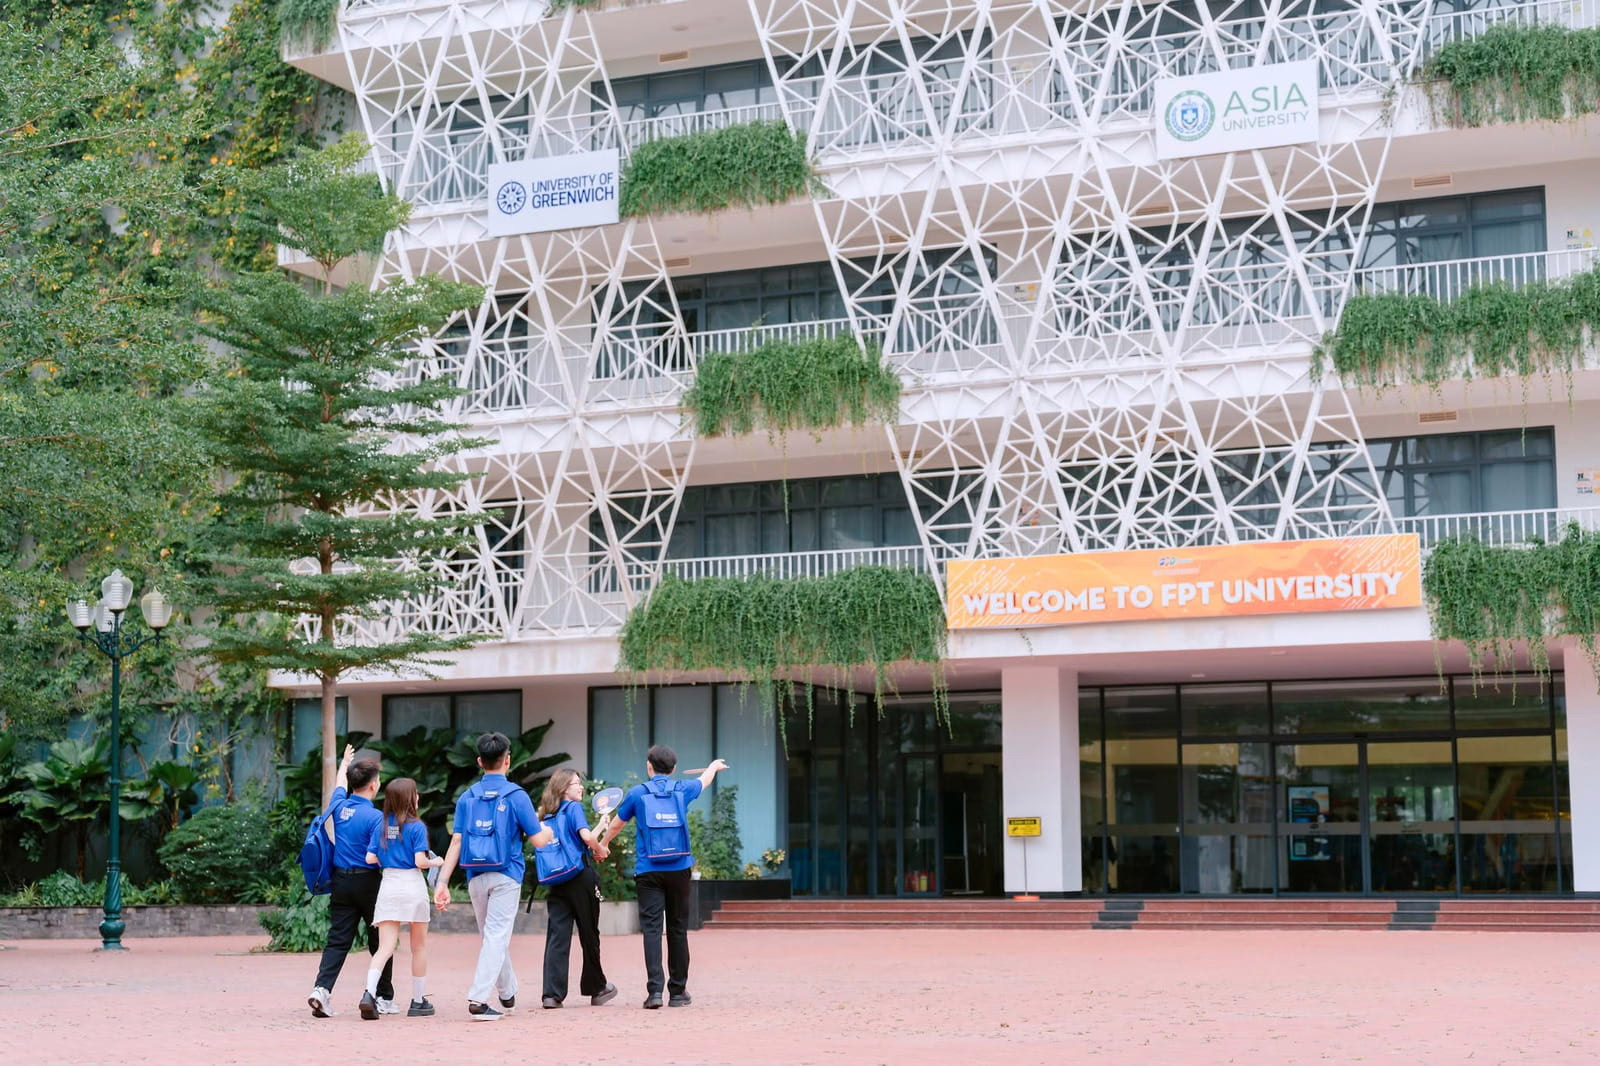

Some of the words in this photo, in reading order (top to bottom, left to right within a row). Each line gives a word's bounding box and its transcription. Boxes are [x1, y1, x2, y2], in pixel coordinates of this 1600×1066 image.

[1223, 82, 1308, 117] ASIA
[1222, 111, 1309, 132] UNIVERSITY
[532, 174, 596, 194] UNIVERSITY
[599, 172, 614, 185] OF
[532, 186, 614, 209] GREENWICH
[962, 587, 1107, 616] WELCOME
[1112, 585, 1153, 609] TO
[1161, 581, 1215, 607] FPT
[1221, 572, 1403, 604] UNIVERSITY
